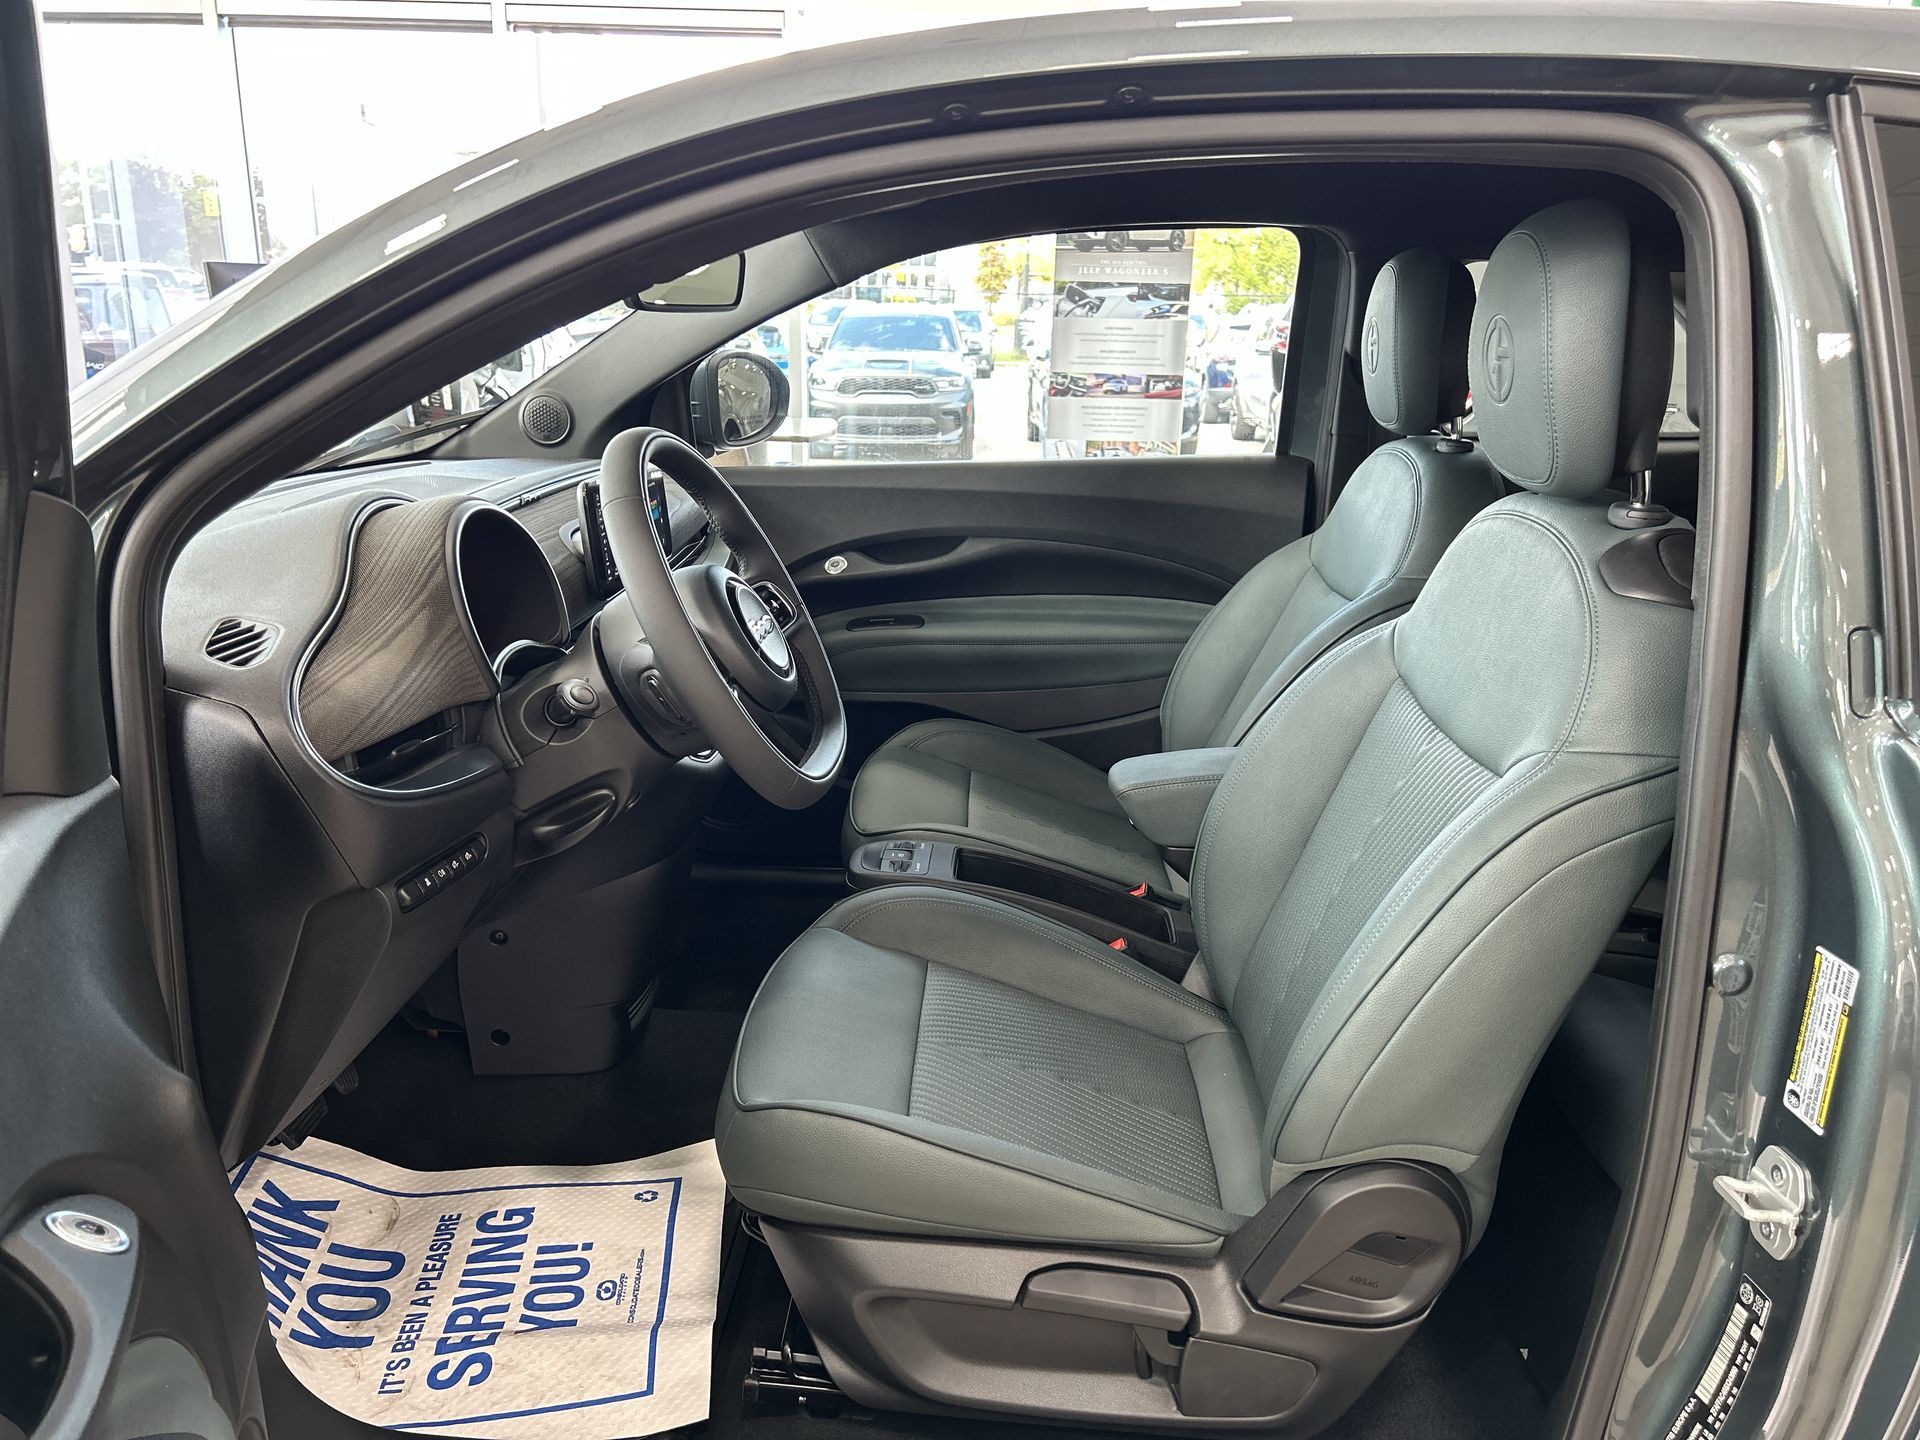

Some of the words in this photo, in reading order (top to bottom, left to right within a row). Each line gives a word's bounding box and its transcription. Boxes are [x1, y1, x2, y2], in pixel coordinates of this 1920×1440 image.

[1077, 266, 1101, 275] JEEP
[1104, 267, 1159, 276] WAGONEER
[415, 1213, 462, 1291] PLEASURE
[289, 1242, 406, 1349] YOU
[410, 1295, 434, 1307] A
[427, 1207, 536, 1390] SERVING
[514, 1242, 594, 1335] YOU!
[616, 1272, 626, 1305] CONSOLIDATED
[1348, 1275, 1380, 1289] AIRBAG
[391, 1312, 428, 1353] BEEN
[378, 1357, 411, 1395] IT'S
[1671, 1410, 1688, 1434] EUROPE
